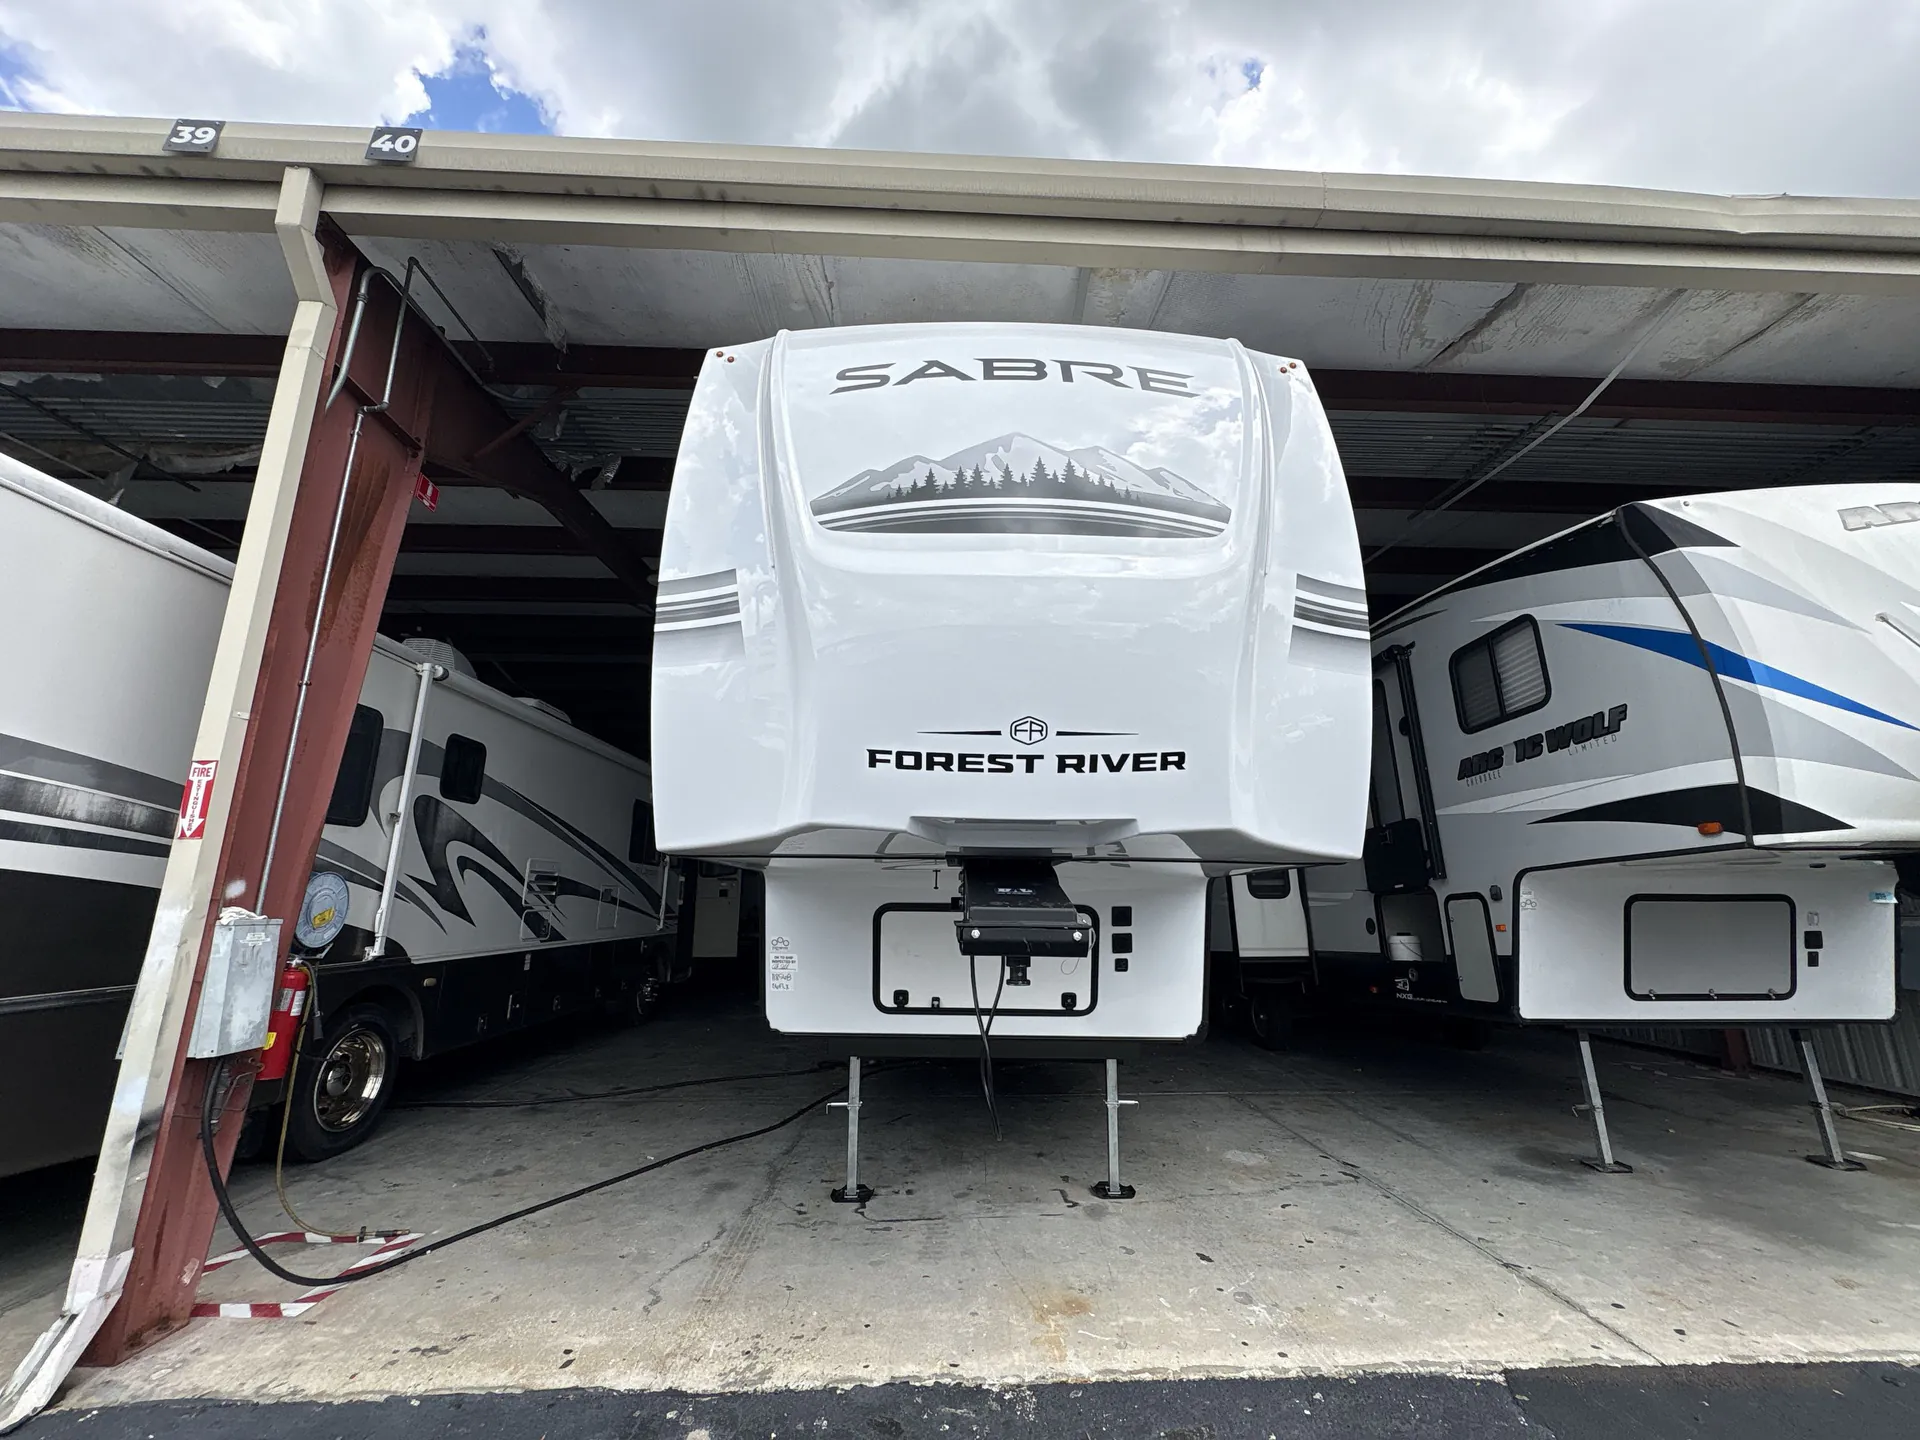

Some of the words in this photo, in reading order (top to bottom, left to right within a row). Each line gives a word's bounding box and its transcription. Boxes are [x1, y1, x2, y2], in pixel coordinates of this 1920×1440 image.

[169, 126, 217, 145] 39
[370, 134, 417, 153] 40
[829, 357, 1201, 399] SABRE
[1545, 703, 1628, 754] WOLF
[1567, 733, 1618, 757] LIMITED
[191, 766, 212, 778] FIRE
[866, 748, 1045, 774] FOREST
[1055, 751, 1187, 774] RIVER
[1466, 769, 1502, 788] CHEROKEE
[186, 779, 203, 832] EXTINGUISHER
